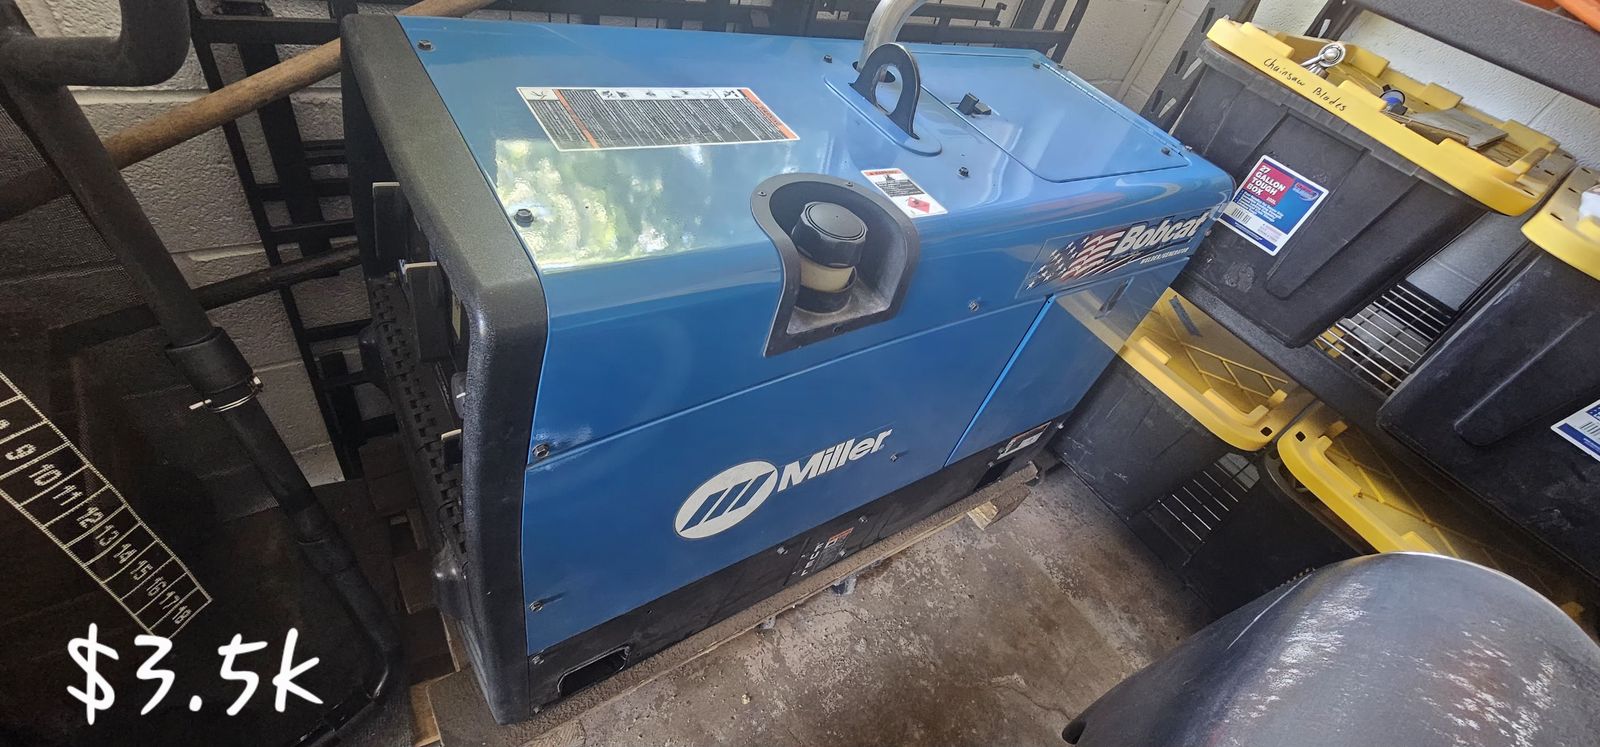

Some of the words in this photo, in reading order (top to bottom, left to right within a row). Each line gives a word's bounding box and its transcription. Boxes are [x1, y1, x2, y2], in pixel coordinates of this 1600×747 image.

[1263, 58, 1306, 87] Chainsaw
[1312, 86, 1347, 112] Blades
[1259, 165, 1271, 174] 27
[1246, 182, 1263, 196] BOX
[1251, 176, 1278, 196] TOUGH
[1255, 171, 1286, 192] GALLON
[1109, 210, 1211, 256] Bobcat
[5, 443, 37, 461] 9
[777, 428, 893, 493] Miller
[28, 463, 62, 487] 10
[52, 484, 83, 507] 11
[76, 506, 105, 529] 12
[95, 524, 120, 547] 13
[113, 543, 138, 564] 14
[130, 559, 154, 581] 15
[146, 576, 168, 597] 16
[159, 591, 181, 610] 17
[172, 605, 192, 625] 18
